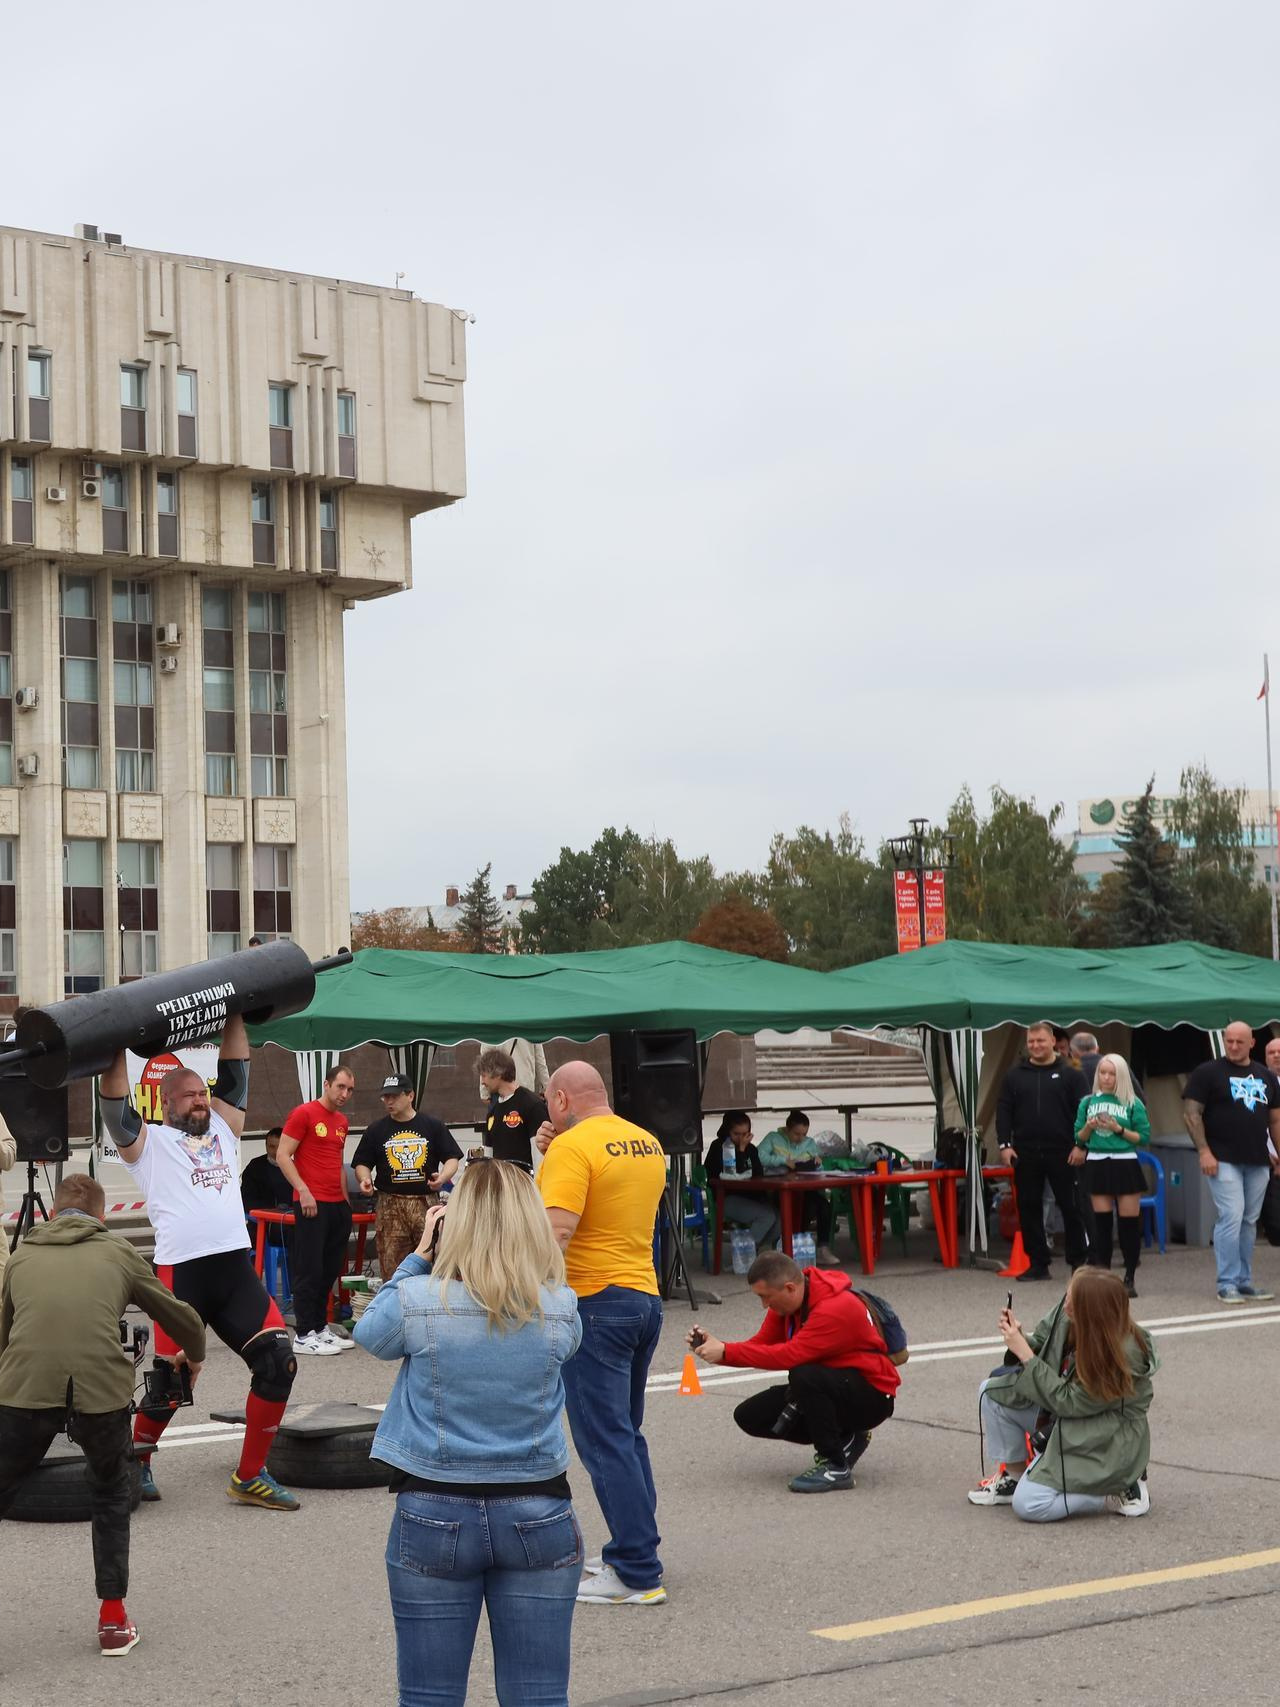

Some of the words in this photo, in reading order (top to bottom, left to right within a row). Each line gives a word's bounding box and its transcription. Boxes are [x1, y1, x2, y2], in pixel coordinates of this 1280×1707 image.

[156, 982, 236, 1016] ФЕДЕРАЦИЯ
[169, 1000, 227, 1031] ТЯЖЁЛОЙ
[606, 1139, 662, 1158] СУДЬЯ
